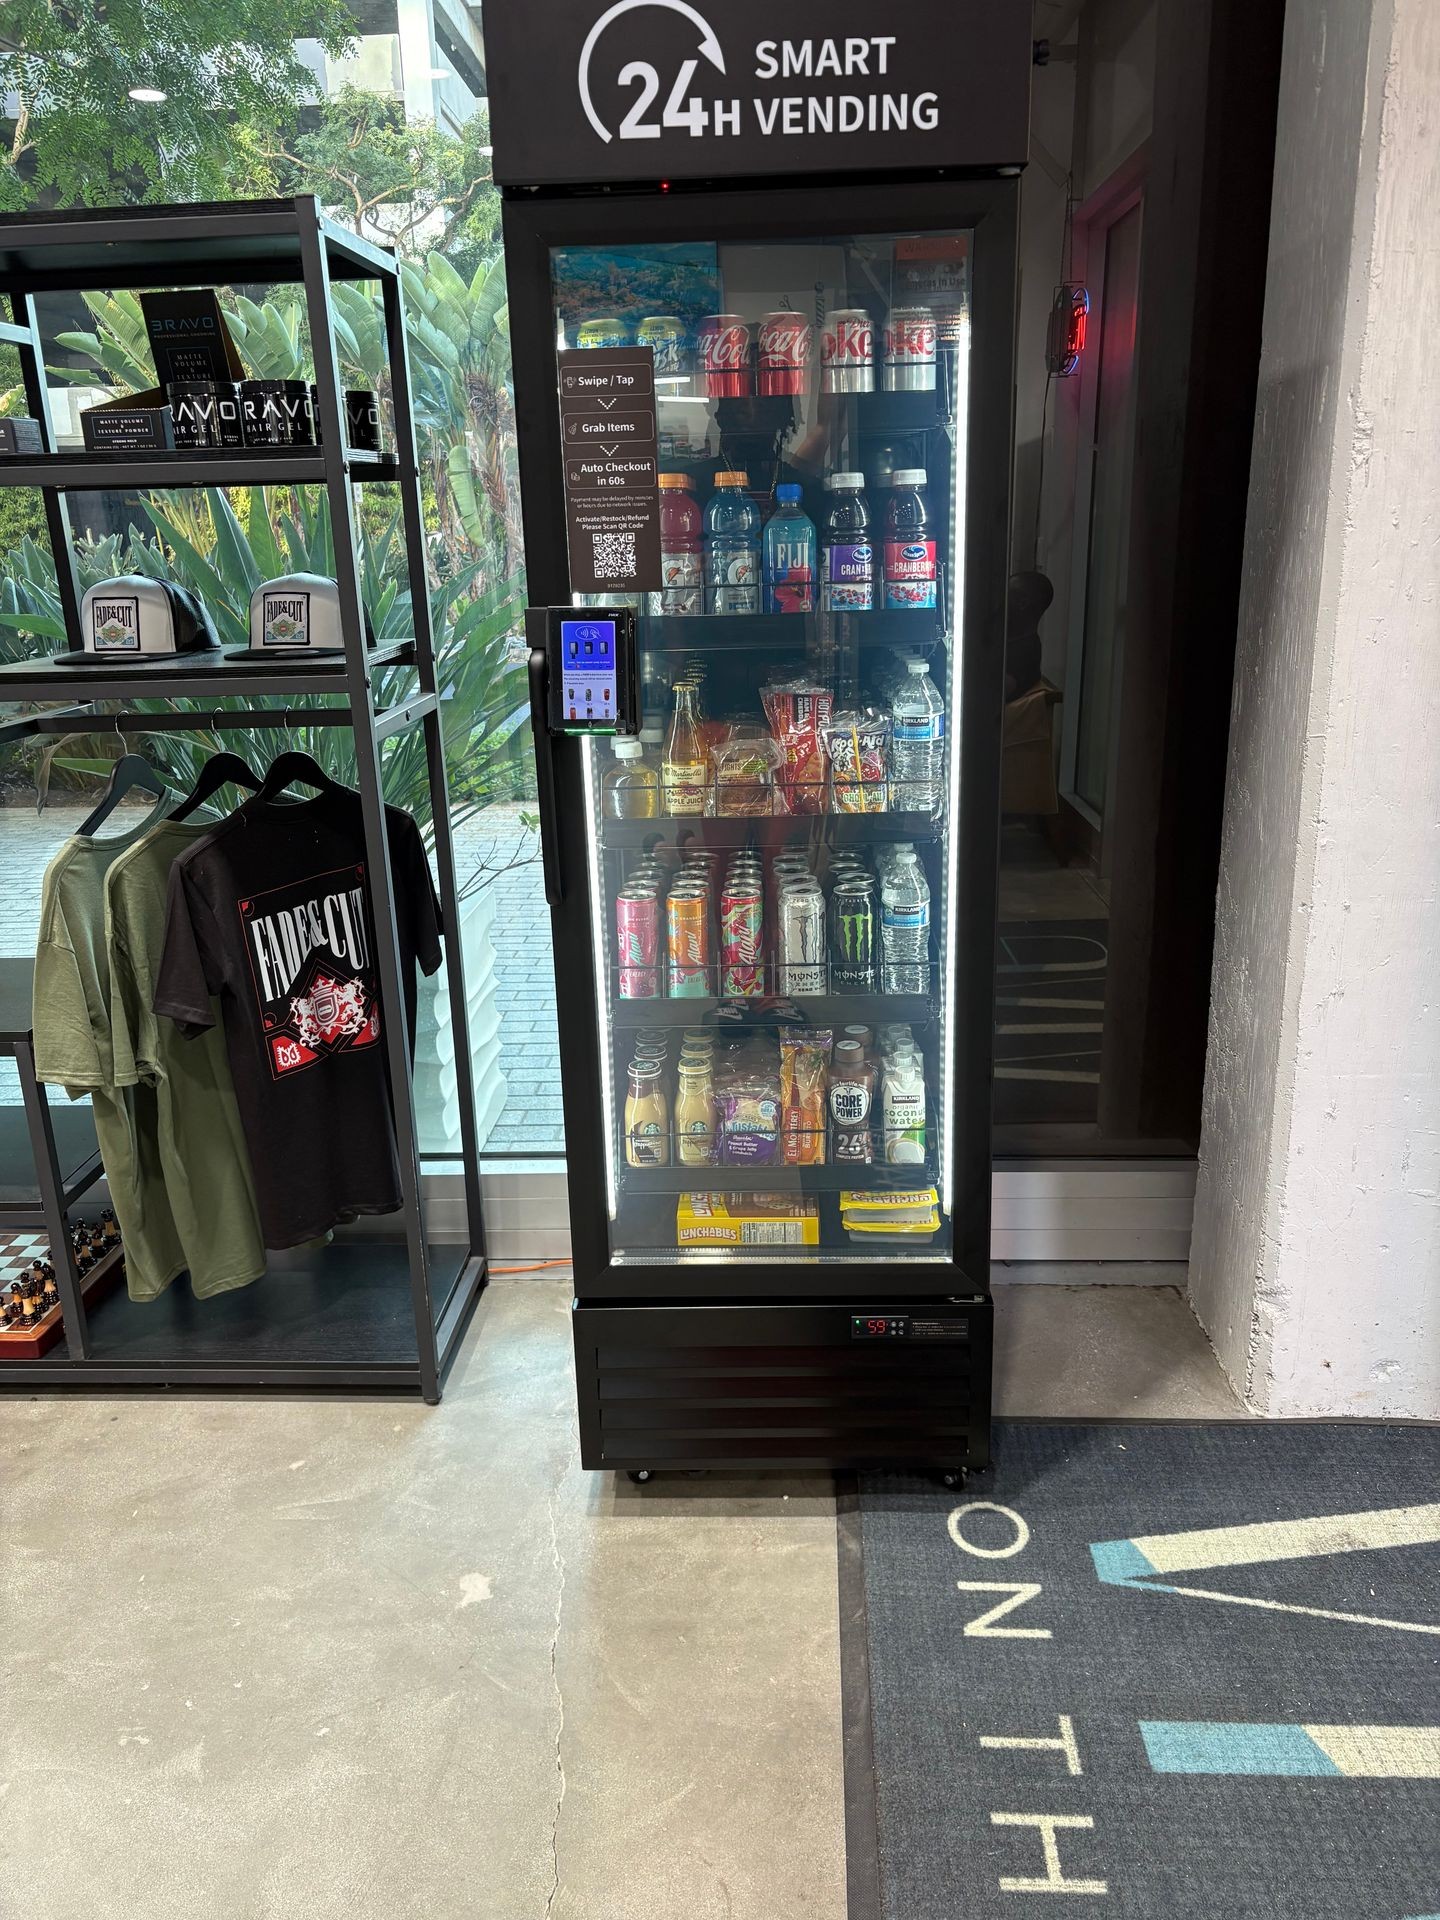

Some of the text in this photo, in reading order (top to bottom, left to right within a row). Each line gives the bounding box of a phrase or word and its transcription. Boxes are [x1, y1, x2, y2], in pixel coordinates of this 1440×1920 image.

[754, 36, 897, 79] SMART
[617, 59, 940, 140] 24H VENDING
[578, 375, 609, 388] Swipe
[616, 374, 635, 386] Tap
[190, 424, 217, 433] GEL
[279, 421, 303, 432] GEL
[582, 422, 635, 433] Grab Items
[581, 461, 652, 473] Auto Checkout
[597, 476, 625, 486] in 60s
[575, 514, 650, 523] Activate/Restock/Refund
[618, 522, 627, 530] QR
[776, 543, 811, 569] FIJI
[95, 604, 133, 628] FADE&CUT
[265, 599, 304, 624] FADE&CUT
[831, 734, 885, 752] Koo-Aid
[835, 1094, 862, 1108] CORE
[835, 1107, 862, 1118] POWER
[889, 1117, 925, 1125] water
[679, 1226, 738, 1241] LUNCHABLES
[867, 1320, 886, 1334] 59
